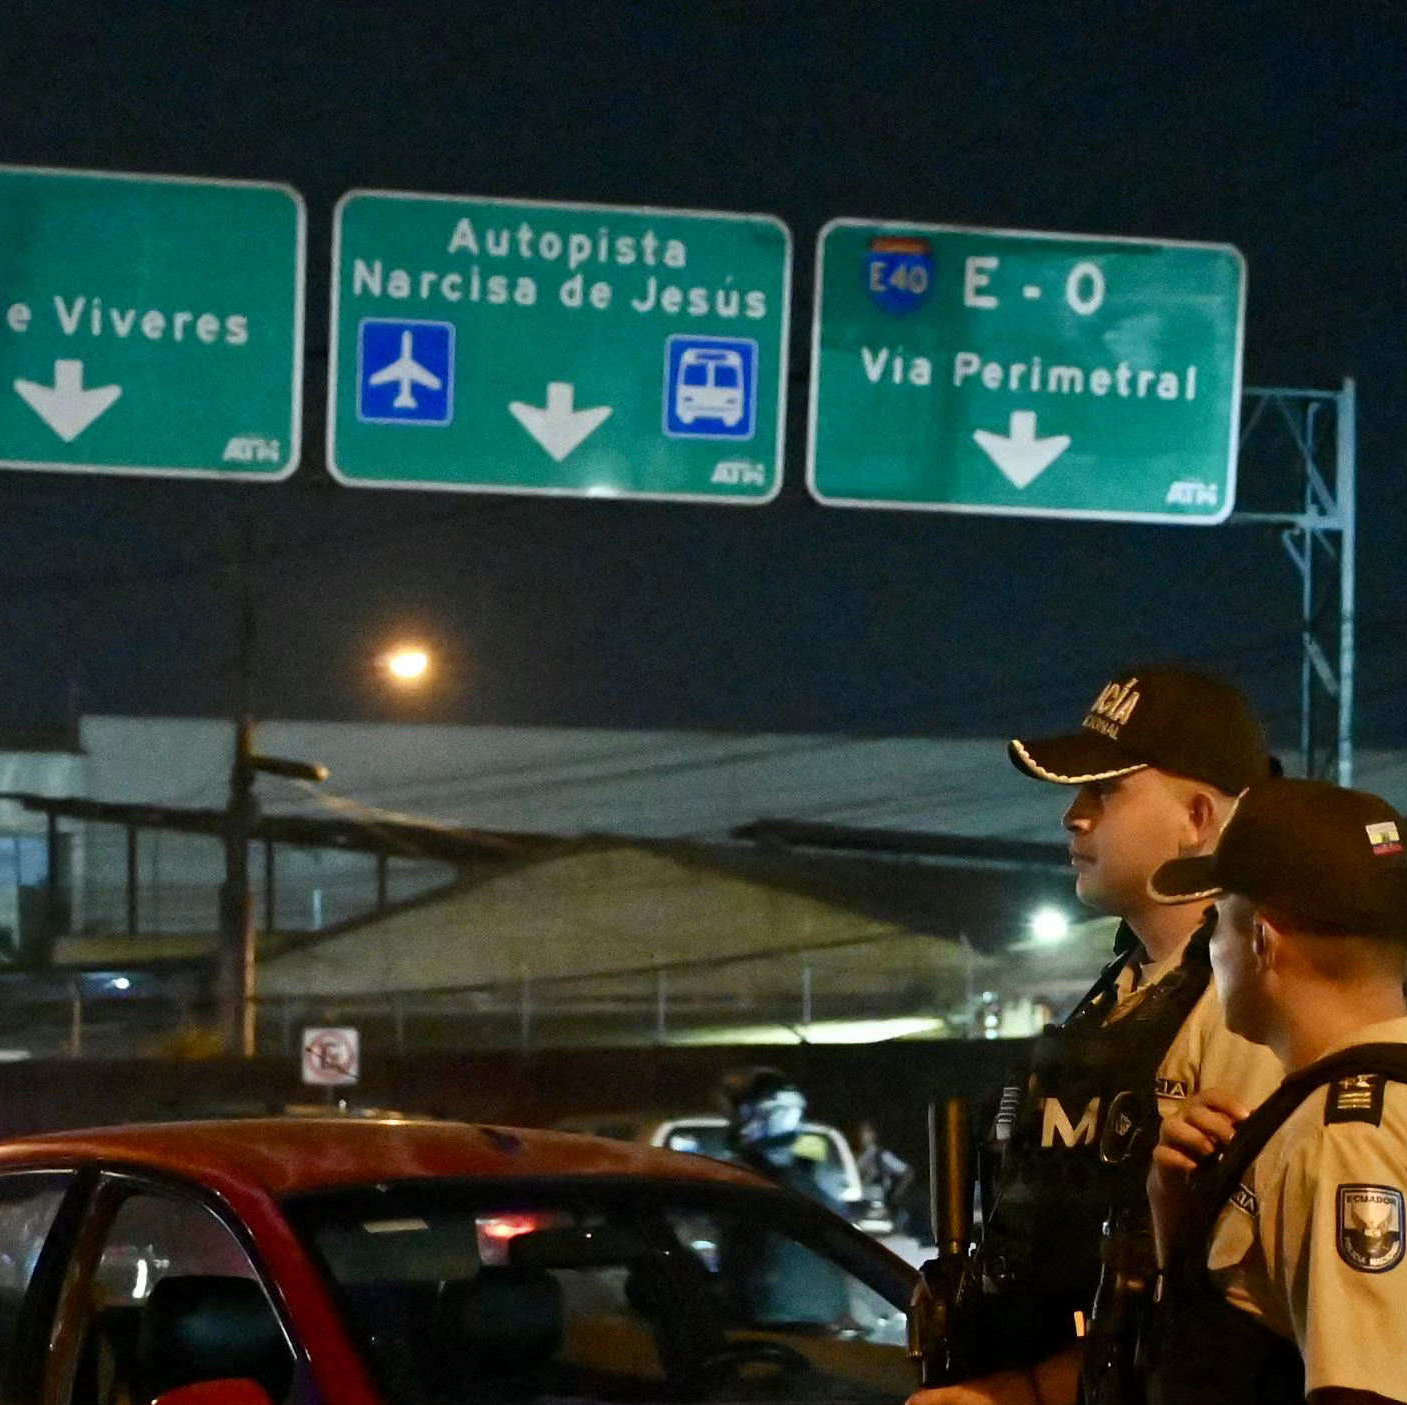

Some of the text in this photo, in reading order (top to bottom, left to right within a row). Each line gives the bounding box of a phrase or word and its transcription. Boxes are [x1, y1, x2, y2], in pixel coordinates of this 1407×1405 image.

[448, 217, 686, 270] Autopista
[353, 259, 766, 318] Narcisa de Jesús
[870, 261, 928, 294] E40
[964, 255, 999, 309] E
[54, 296, 249, 345] Viveres
[953, 351, 1197, 400] Perimetral
[1346, 1193, 1397, 1206] ECUADOR
